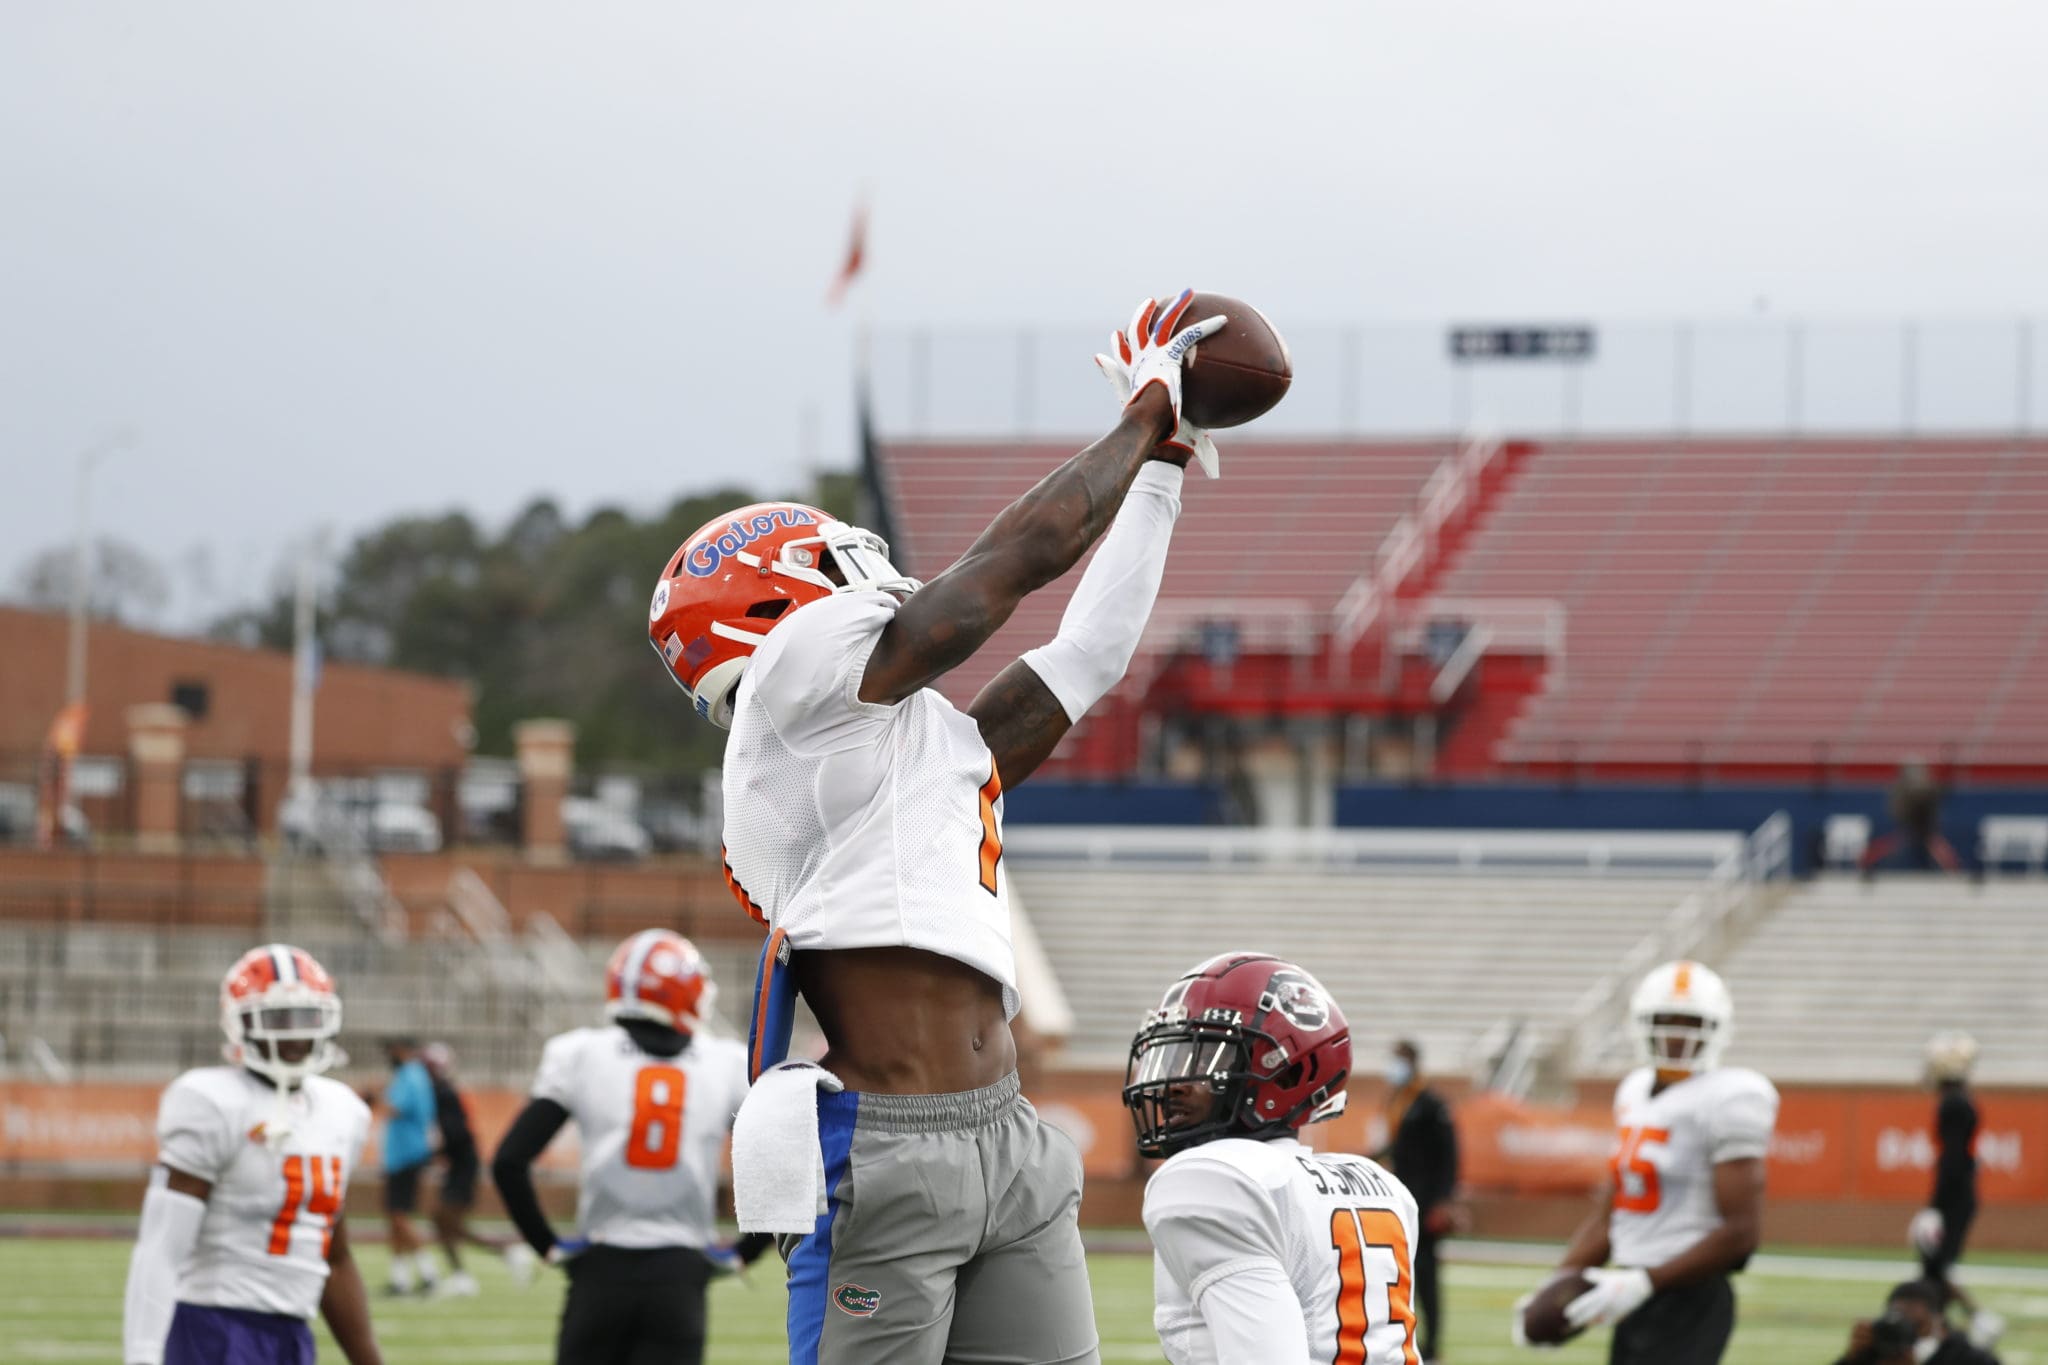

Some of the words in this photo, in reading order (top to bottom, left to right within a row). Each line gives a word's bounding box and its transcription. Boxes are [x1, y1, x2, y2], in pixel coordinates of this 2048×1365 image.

[1167, 326, 1203, 361] GATORS
[686, 506, 817, 577] Gators
[626, 1064, 687, 1172] 8
[267, 1155, 343, 1260] 14
[1330, 1207, 1418, 1365] 13
